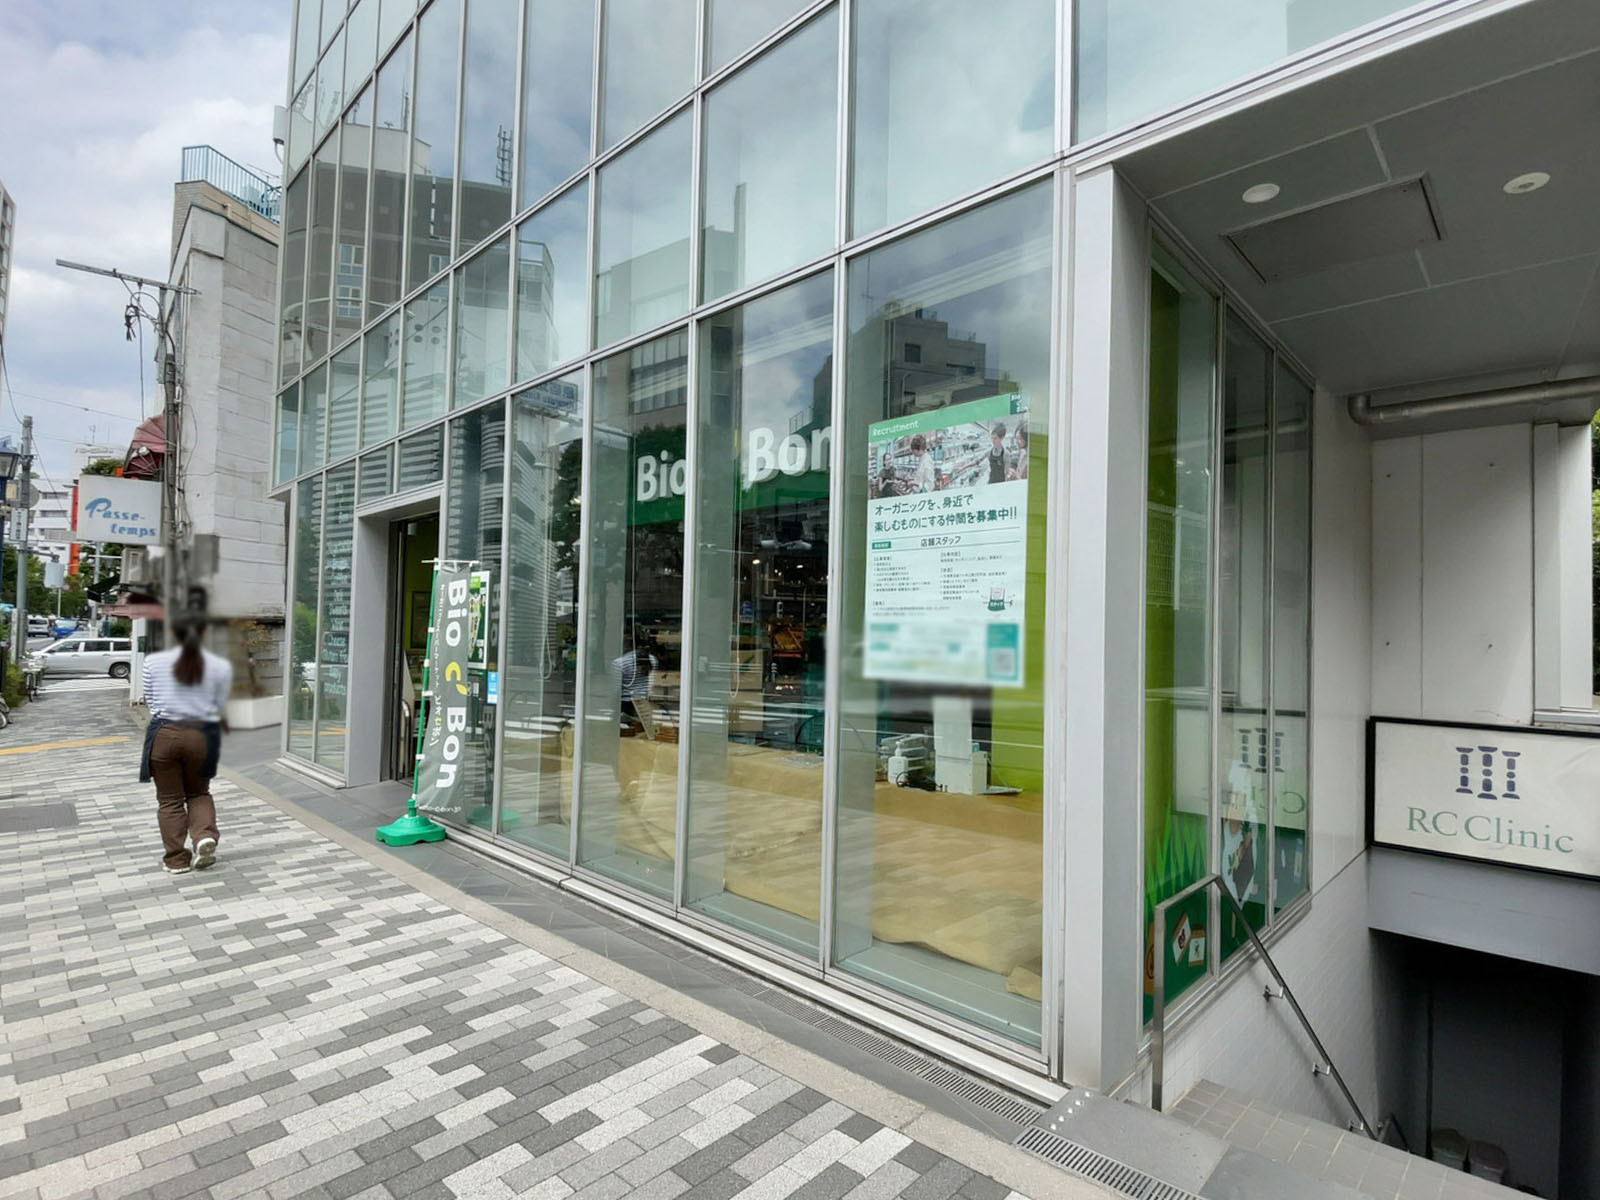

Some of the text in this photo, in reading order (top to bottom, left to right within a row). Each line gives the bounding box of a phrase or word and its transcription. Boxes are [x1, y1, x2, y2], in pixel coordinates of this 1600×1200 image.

[873, 420, 919, 436] Recruitment
[637, 450, 686, 501] Bio
[875, 494, 974, 516] オーガニックを、身近で
[110, 523, 157, 537] temps
[446, 579, 467, 647] Bio
[436, 707, 467, 788] Bon
[1407, 806, 1574, 853] RC Clinic
